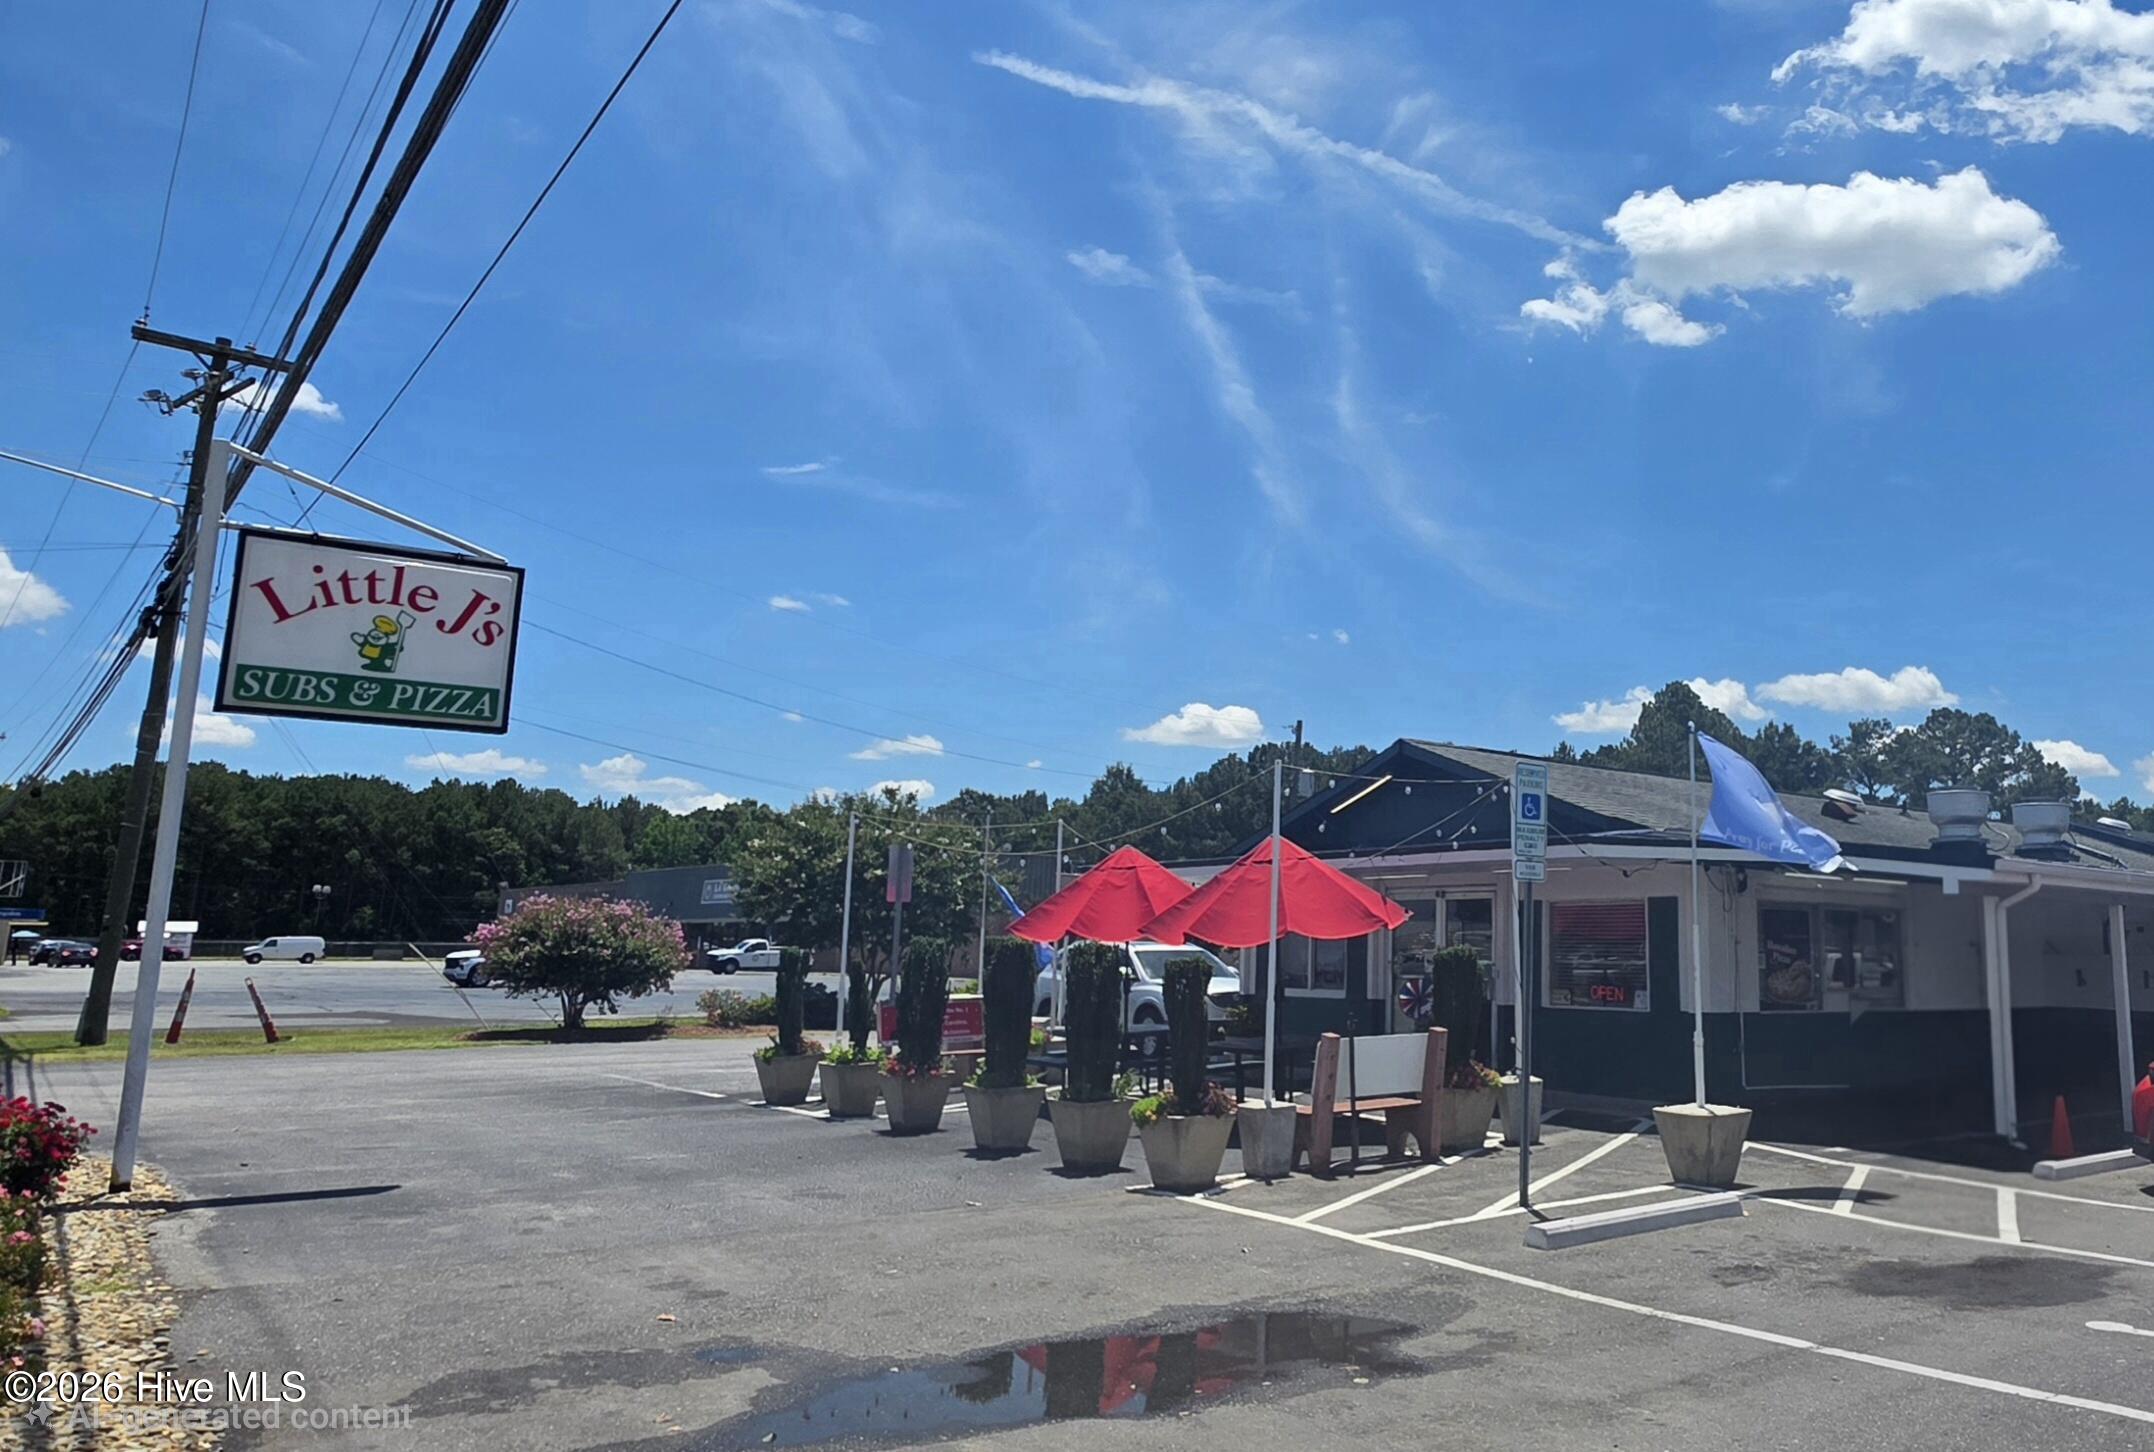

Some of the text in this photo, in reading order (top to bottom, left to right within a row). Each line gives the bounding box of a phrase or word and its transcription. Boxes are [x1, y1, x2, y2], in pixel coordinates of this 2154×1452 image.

[250, 565, 504, 646] Little J's
[239, 669, 492, 718] SUBS & PIZZA
[1590, 985, 1624, 1001] OPEN
